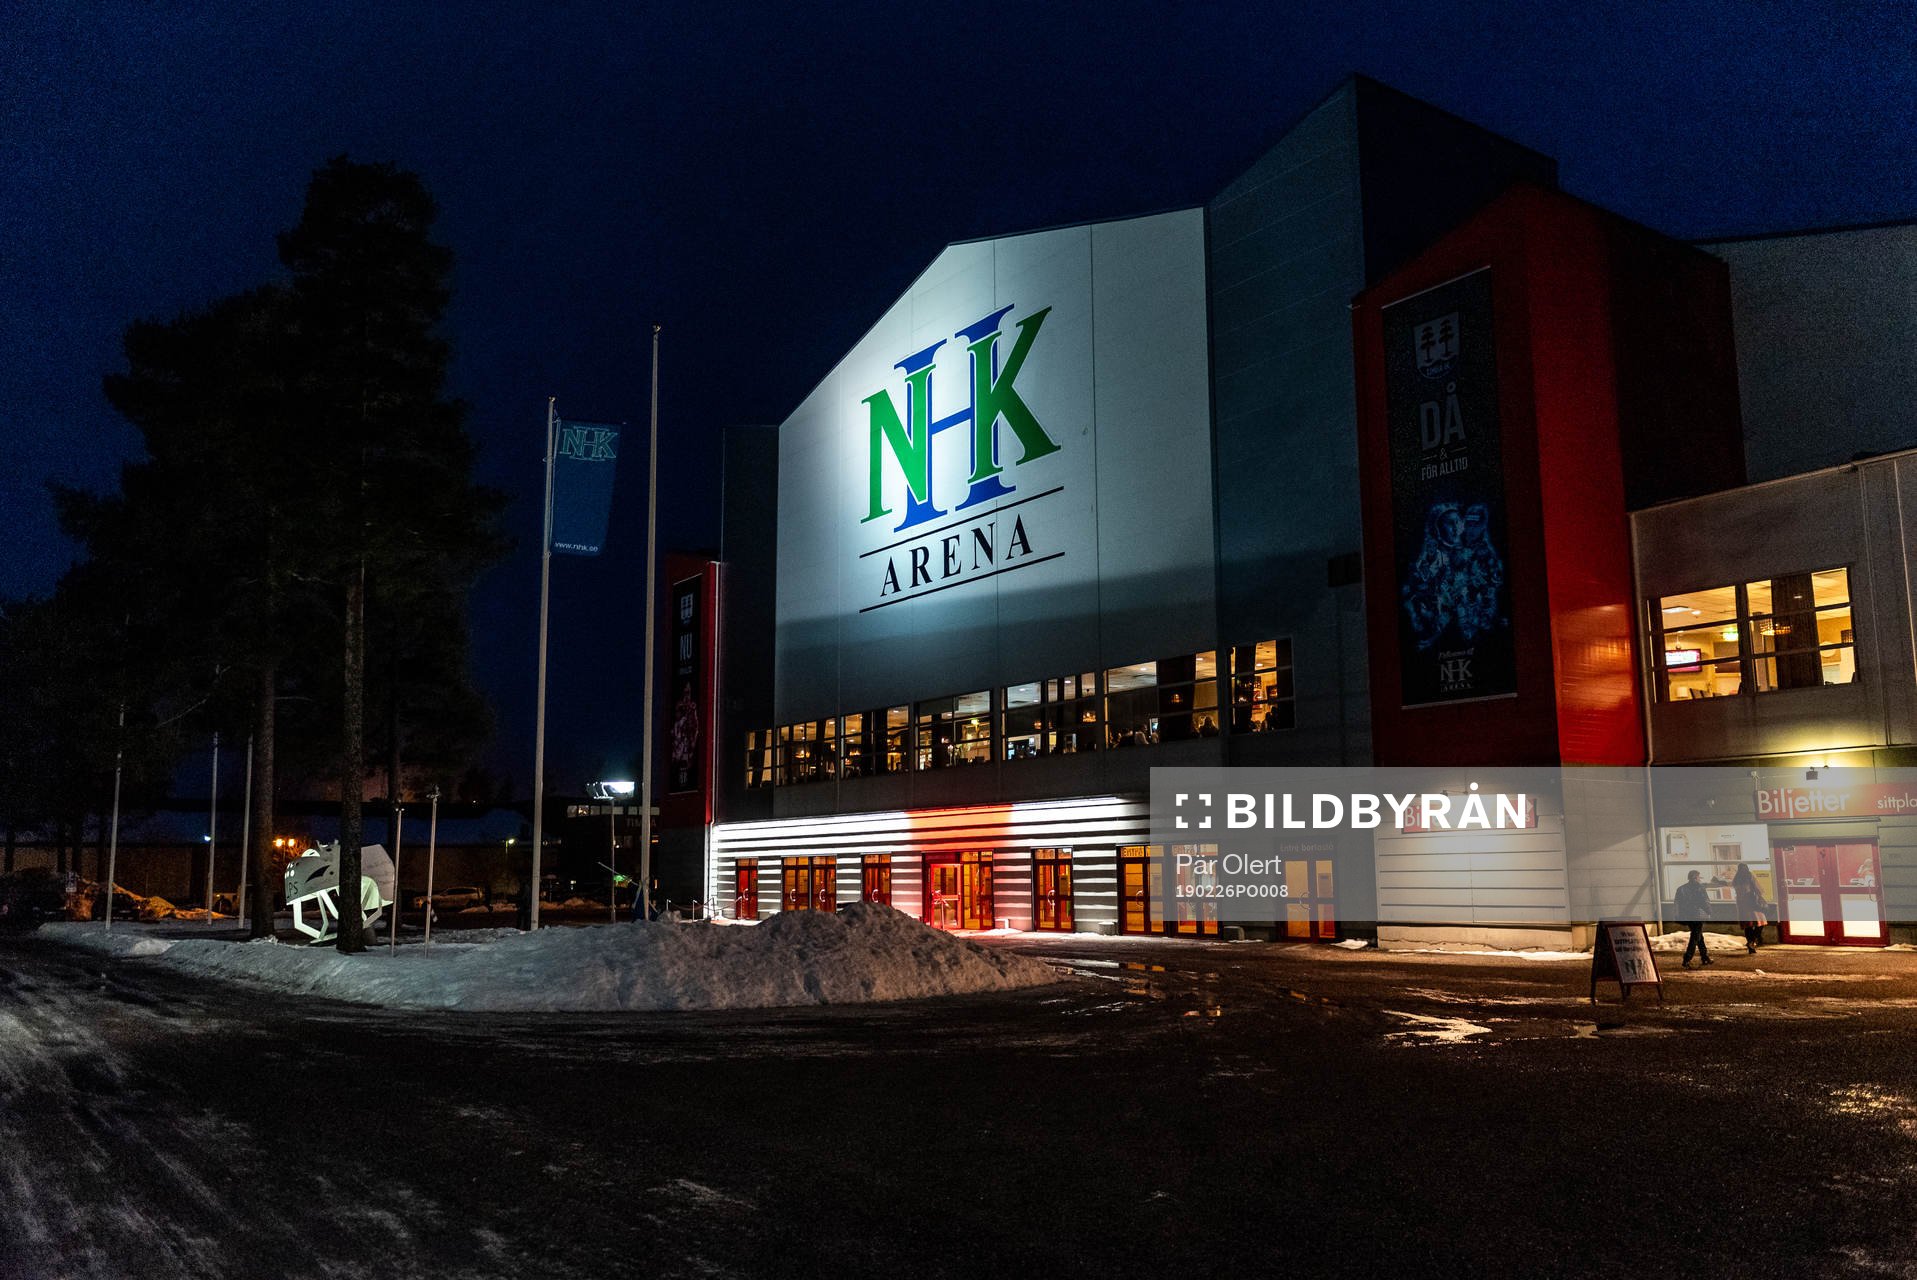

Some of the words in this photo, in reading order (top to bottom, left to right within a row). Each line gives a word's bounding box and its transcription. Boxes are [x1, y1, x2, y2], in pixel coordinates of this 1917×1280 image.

[1420, 381, 1467, 451] DÅ
[1421, 464, 1438, 480] FÖR
[1440, 457, 1468, 476] ALLTID
[880, 513, 1033, 597] ARENA
[1758, 789, 1848, 818] Biljetter
